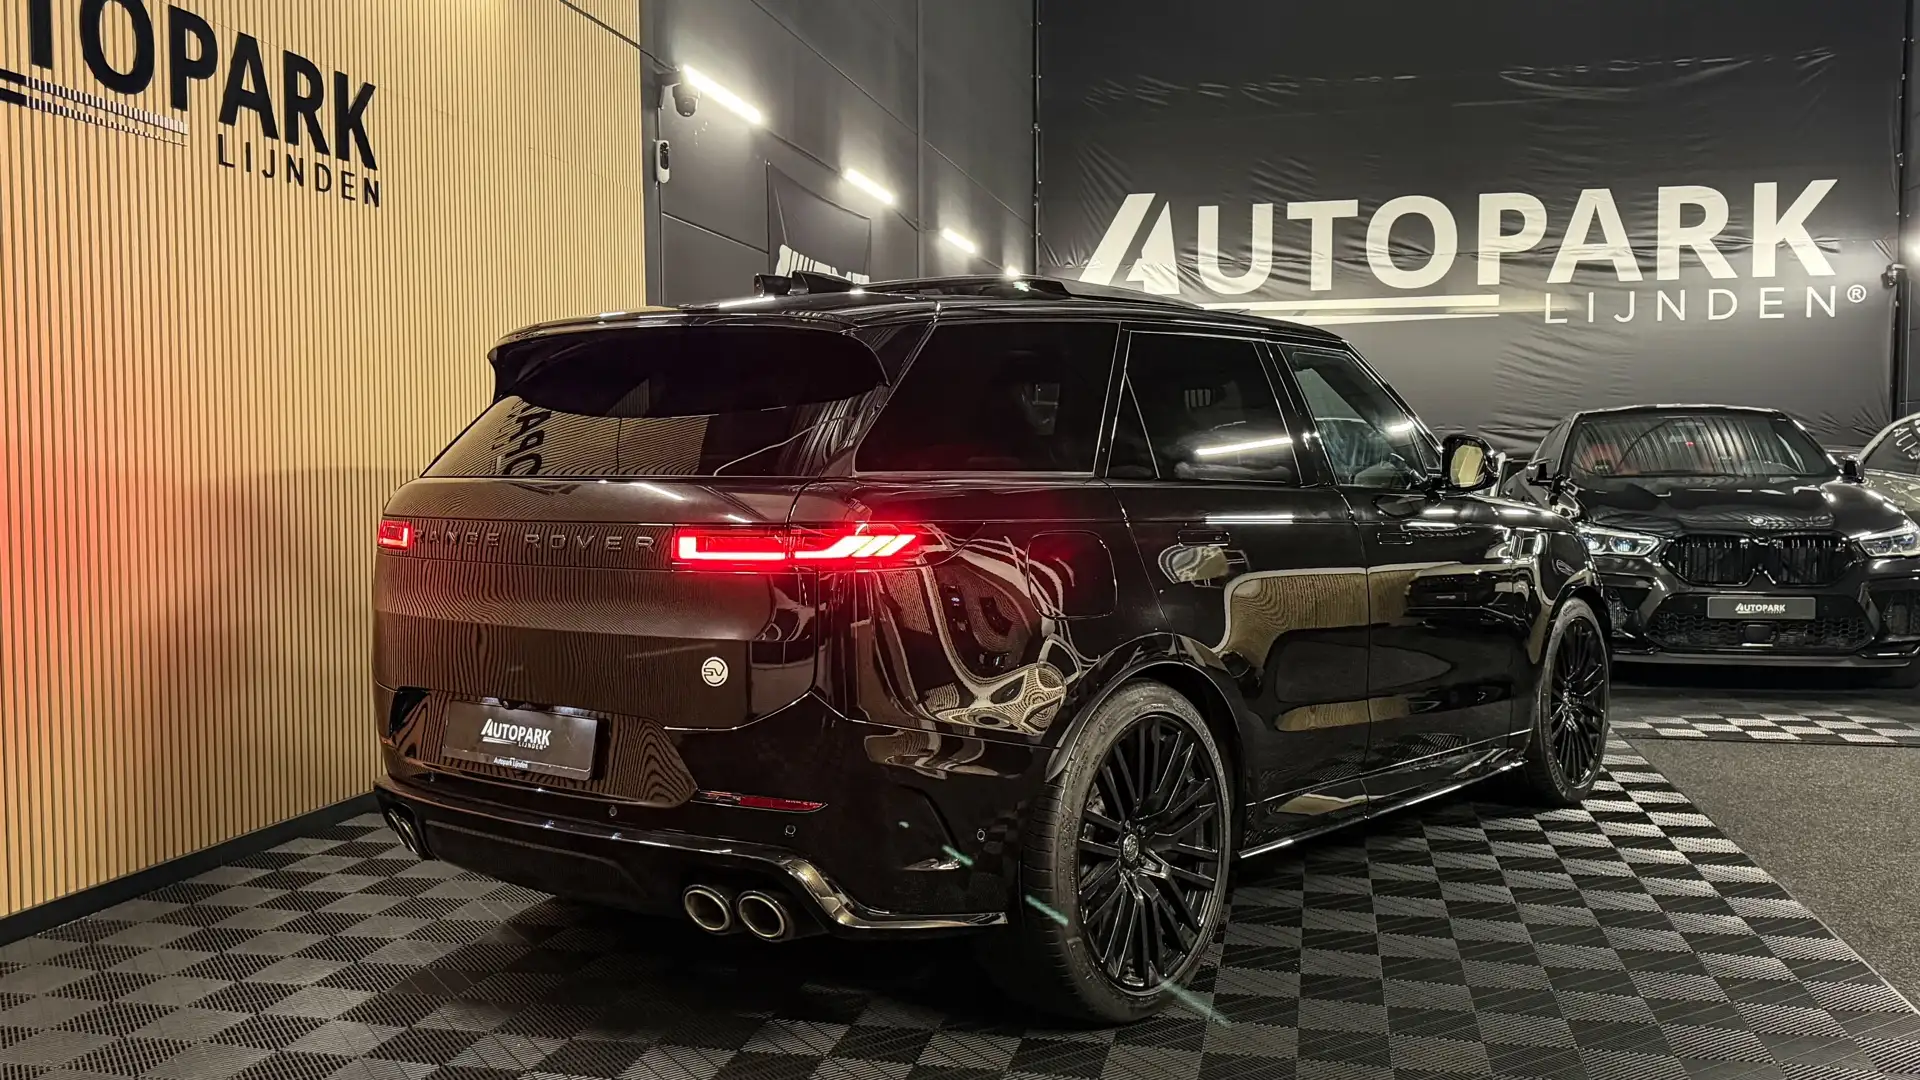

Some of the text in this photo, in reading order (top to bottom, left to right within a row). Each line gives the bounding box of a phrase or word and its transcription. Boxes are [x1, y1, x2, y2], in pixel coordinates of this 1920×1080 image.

[217, 133, 380, 208] LIJNDEN
[1078, 178, 1838, 295] AUTOPARK
[413, 529, 655, 552] RANGE ROVER
[1735, 602, 1786, 612] AUTOPARK
[480, 718, 552, 746] AUTOPARK
